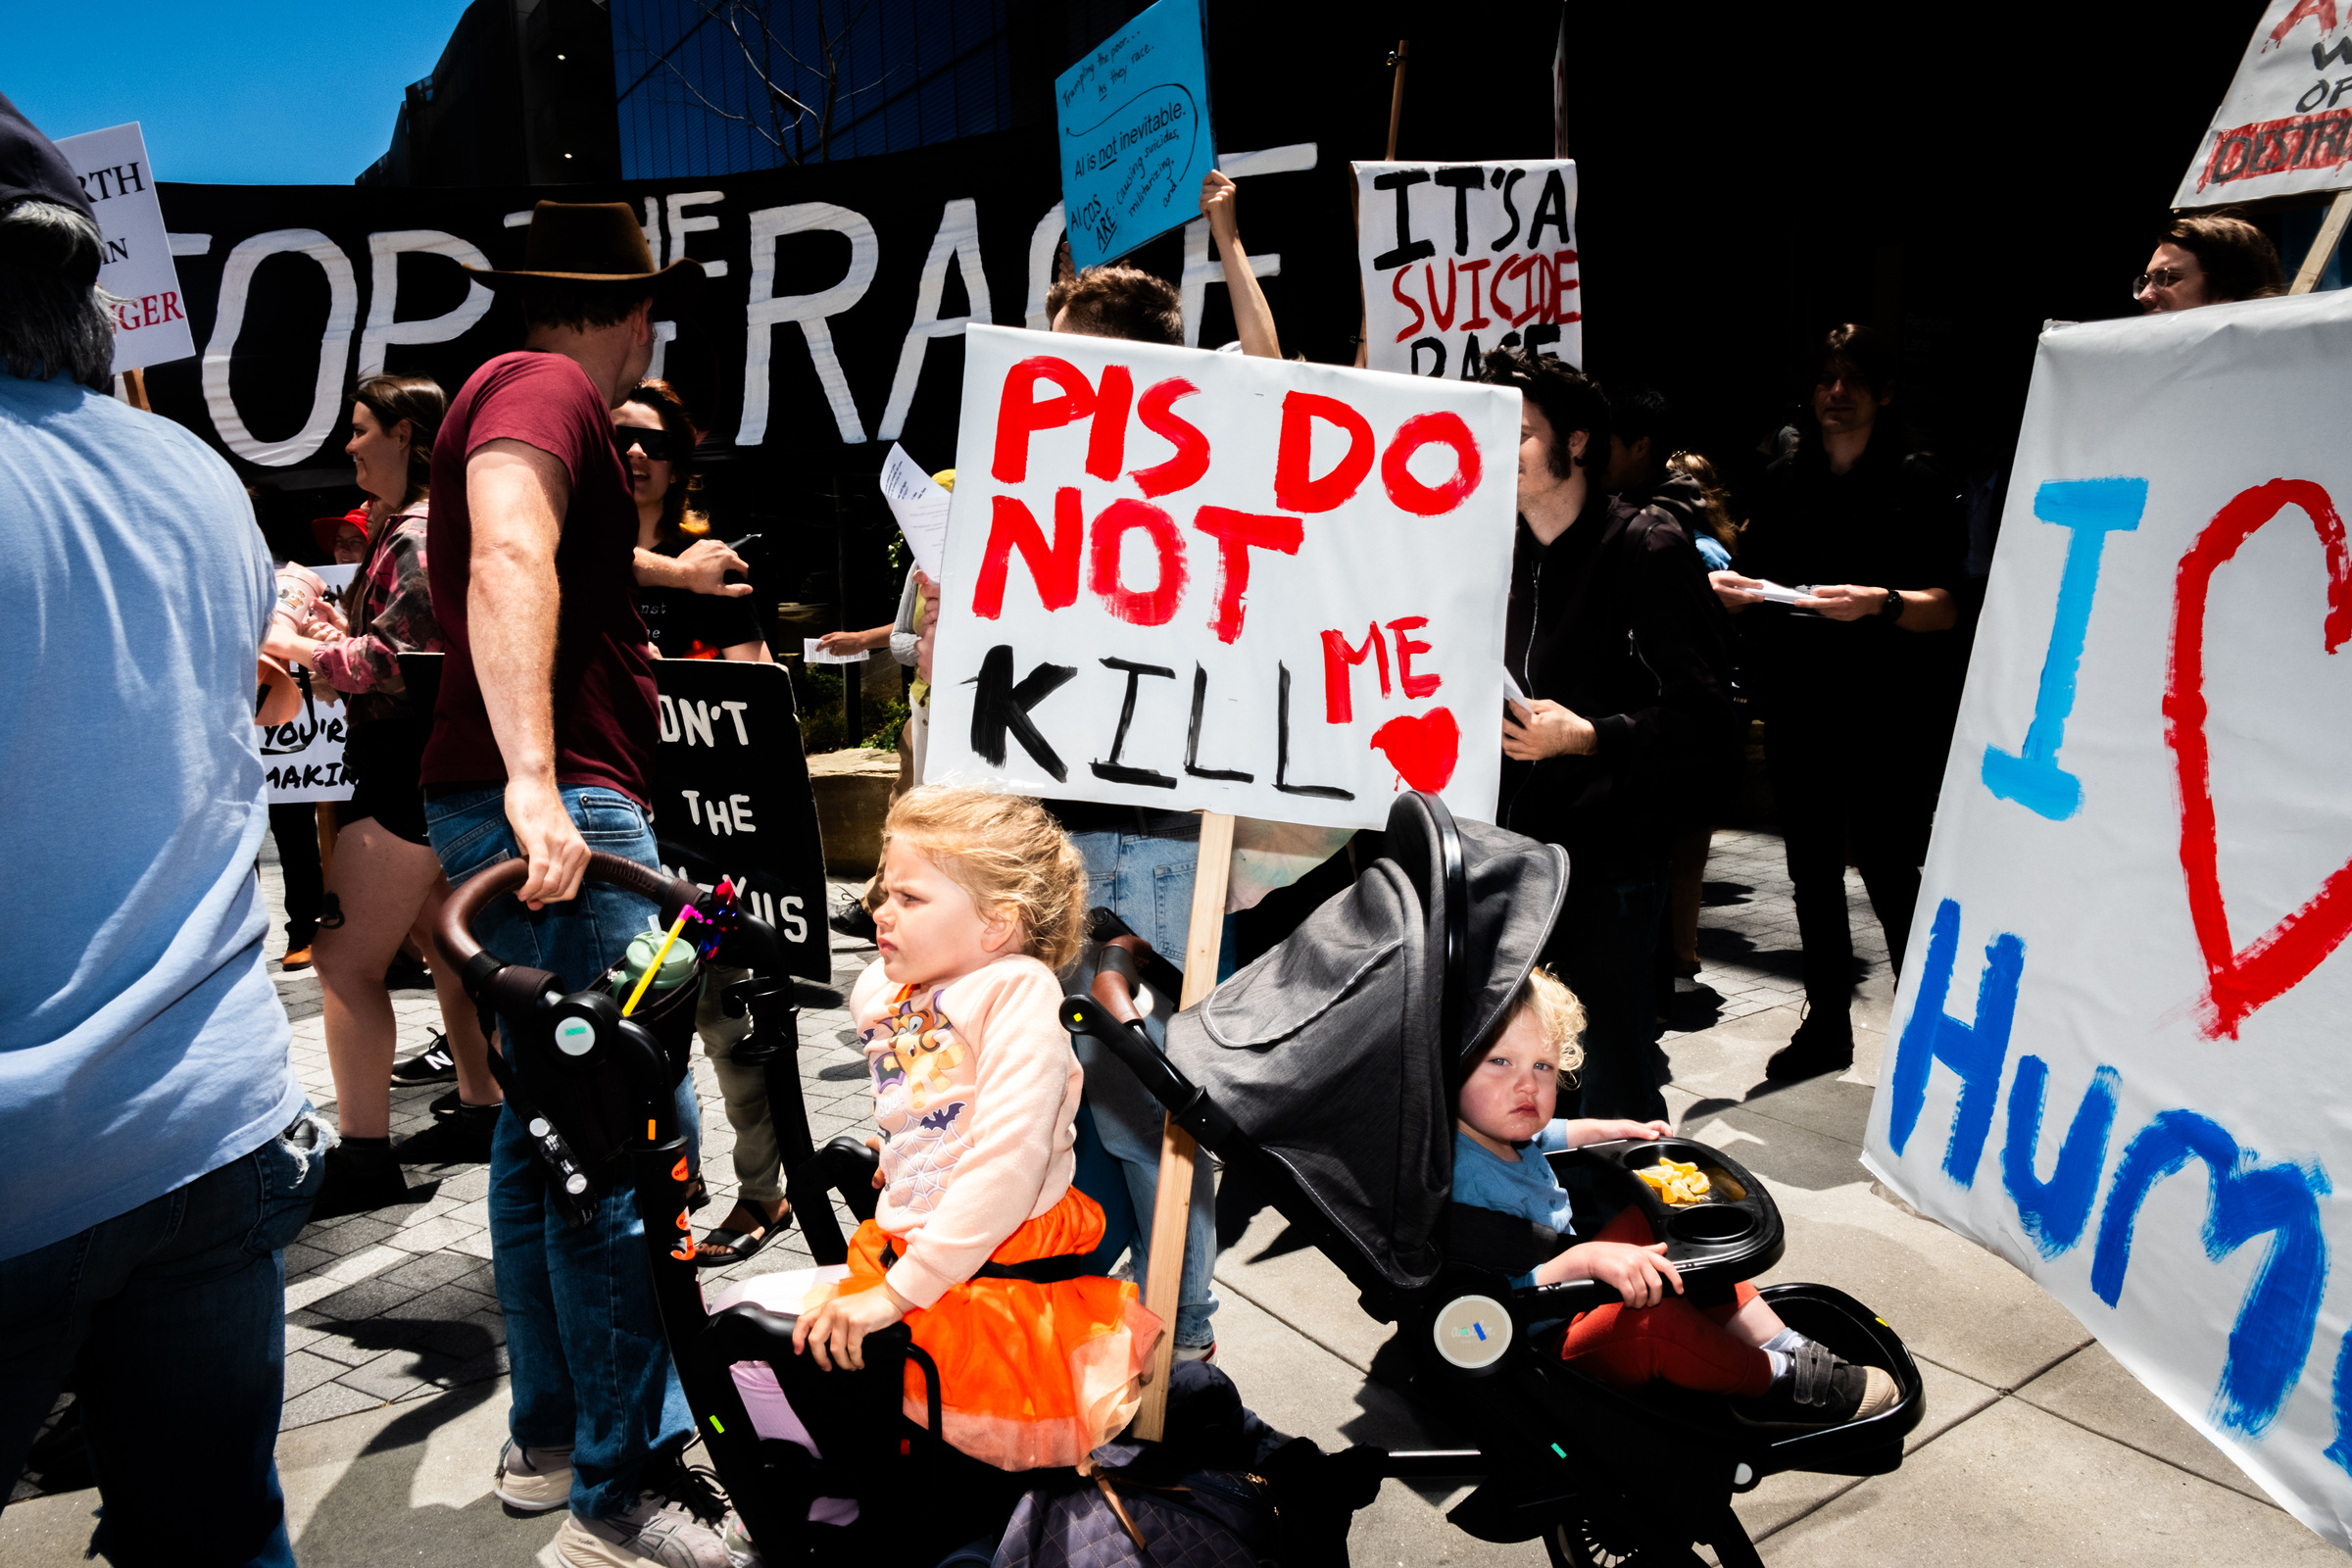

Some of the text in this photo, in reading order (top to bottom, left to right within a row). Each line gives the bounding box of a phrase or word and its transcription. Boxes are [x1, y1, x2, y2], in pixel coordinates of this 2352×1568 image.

[1062, 64, 1096, 108] Trampling
[1098, 52, 1109, 67] the
[1110, 66, 1127, 85] they
[1131, 44, 1154, 64] race.
[2296, 75, 2352, 113] OF
[1087, 153, 1096, 172] is
[1099, 136, 1117, 165] not
[1120, 102, 1186, 151] inevitable.
[1117, 157, 1146, 205] causing
[1162, 178, 1177, 208] and
[1393, 250, 1581, 343] SUICIDE
[169, 228, 496, 467] OP
[1410, 323, 1561, 381] RAE
[1274, 390, 1484, 517] DO
[972, 486, 1304, 645] NOT
[965, 616, 1444, 801] KILL ME
[682, 790, 757, 836] THE
[424, 1051, 454, 1070] N
